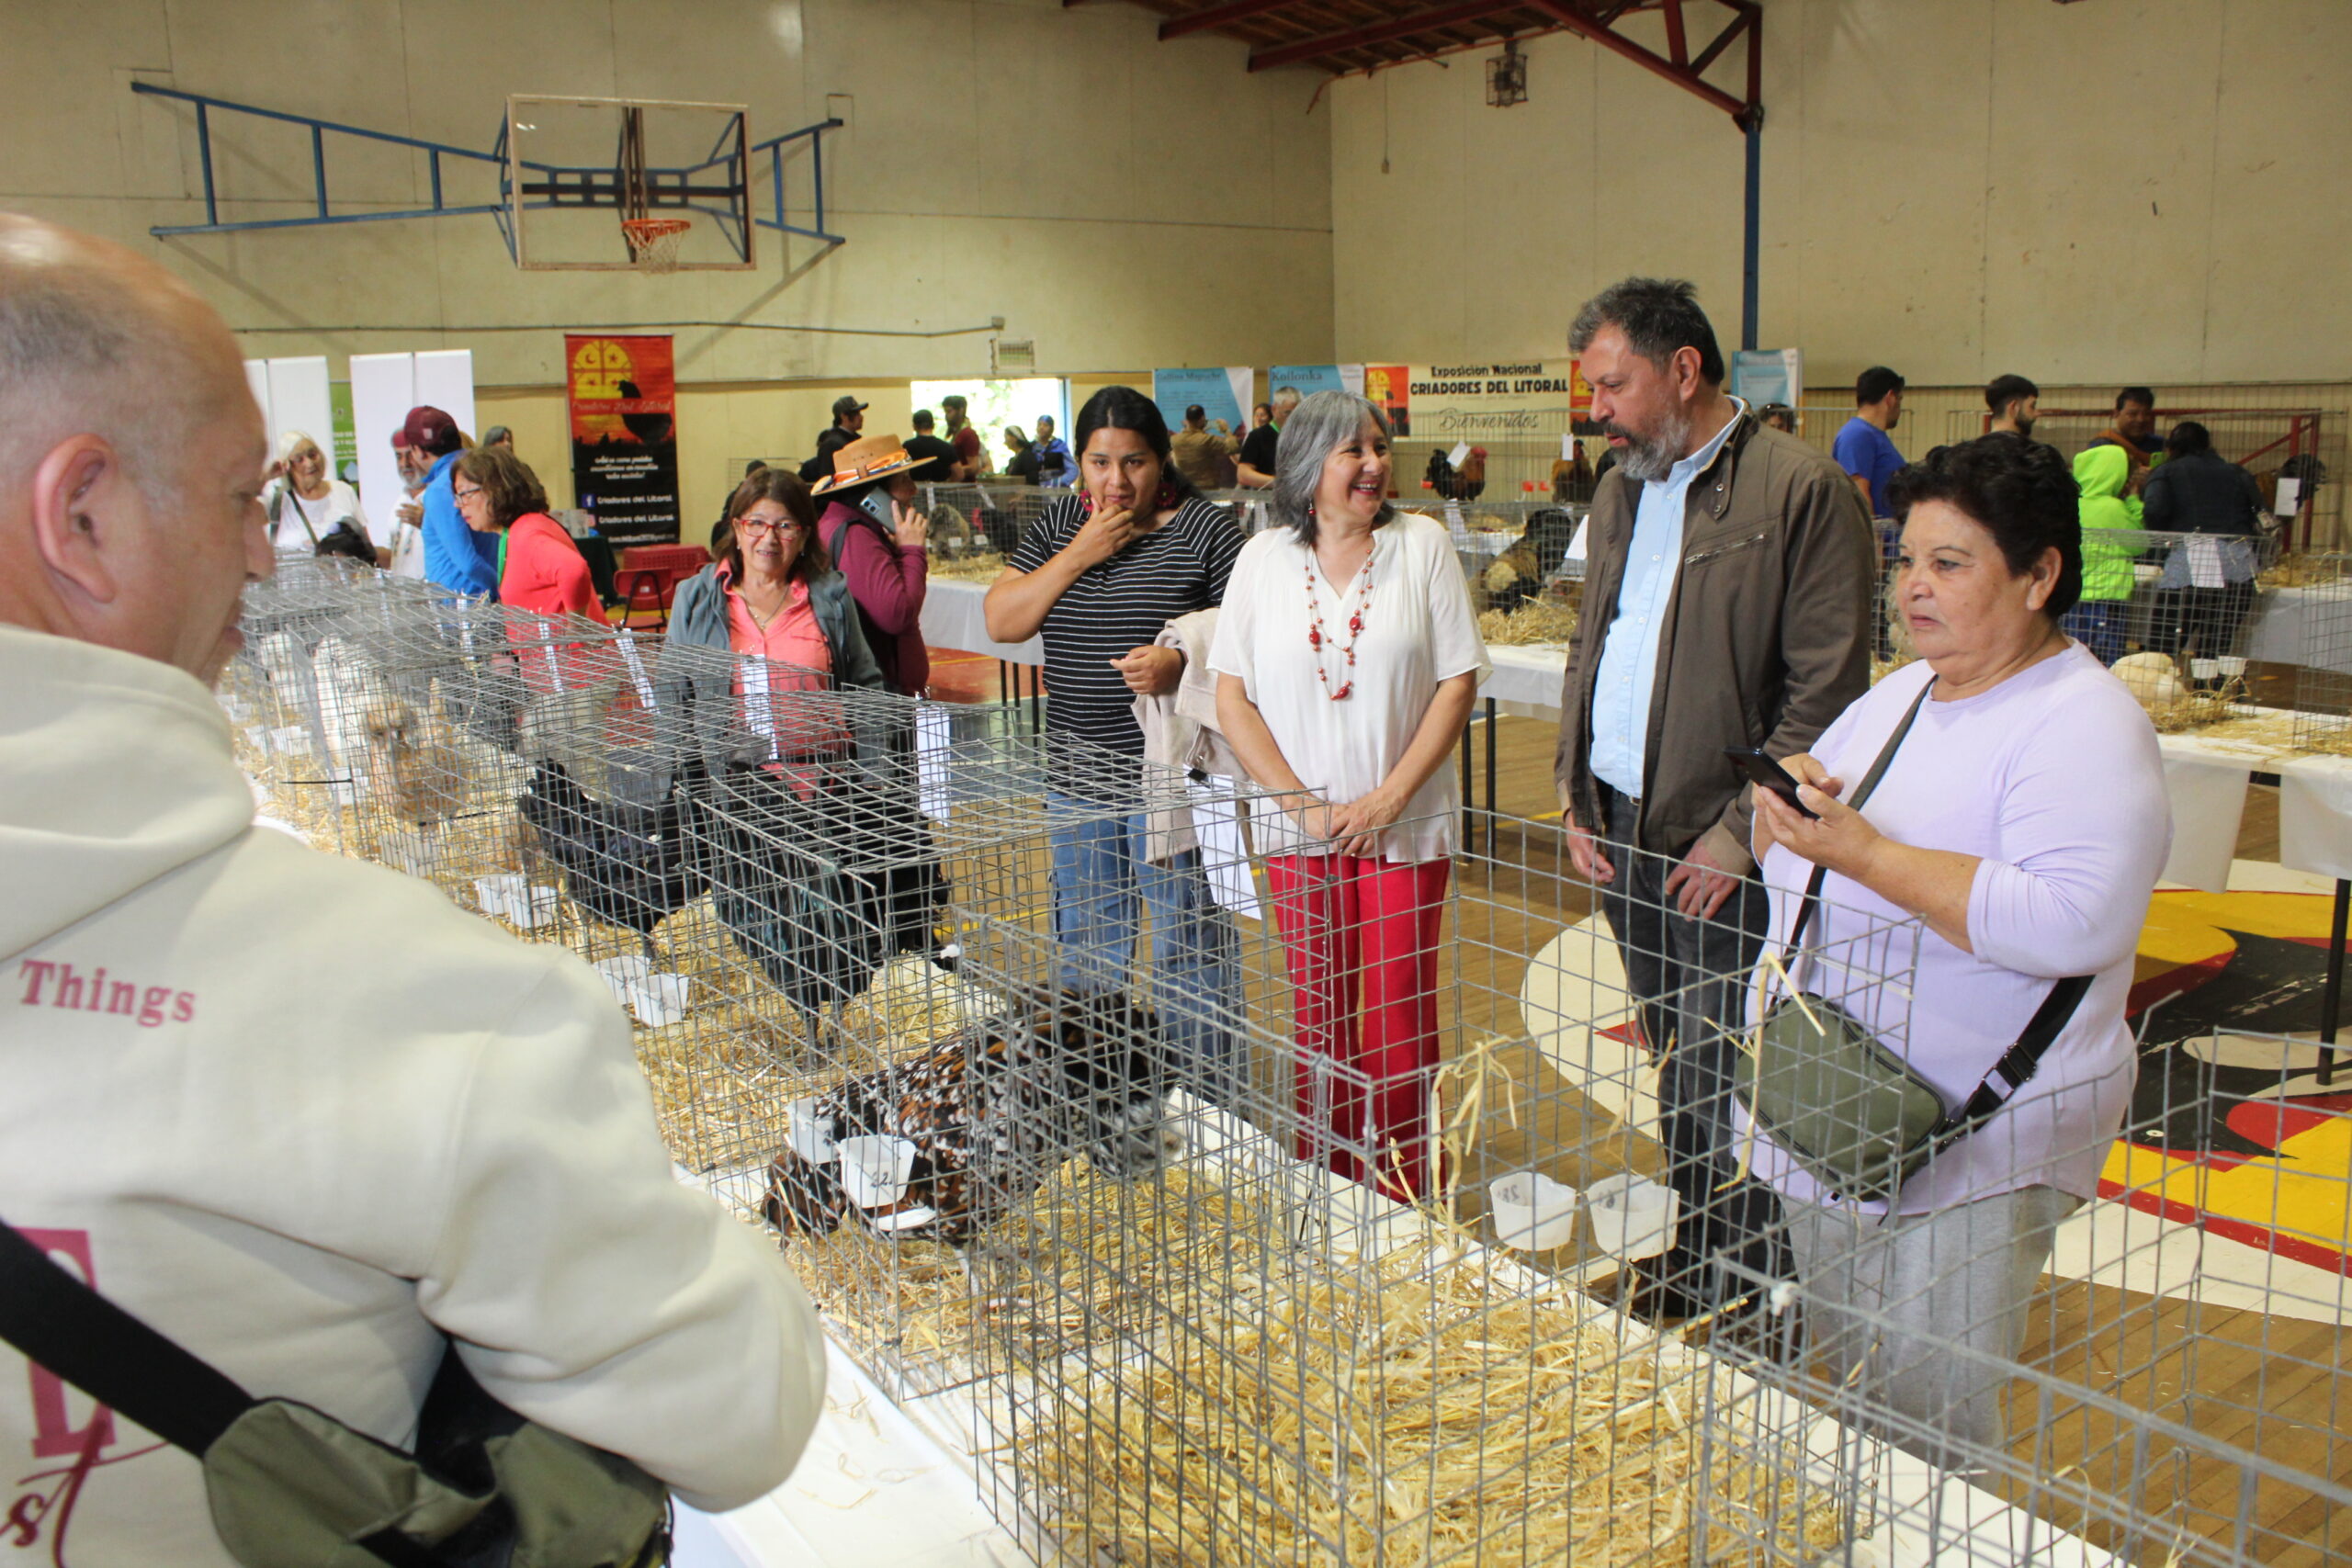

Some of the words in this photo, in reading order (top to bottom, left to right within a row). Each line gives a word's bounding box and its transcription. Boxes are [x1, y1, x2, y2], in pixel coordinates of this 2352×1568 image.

[1492, 363, 1542, 376] Nacional
[1410, 381, 1481, 395] CRIADORES
[1487, 380, 1509, 393] DEL
[1514, 379, 1568, 393] LITORAL
[18, 958, 196, 1027] Things
